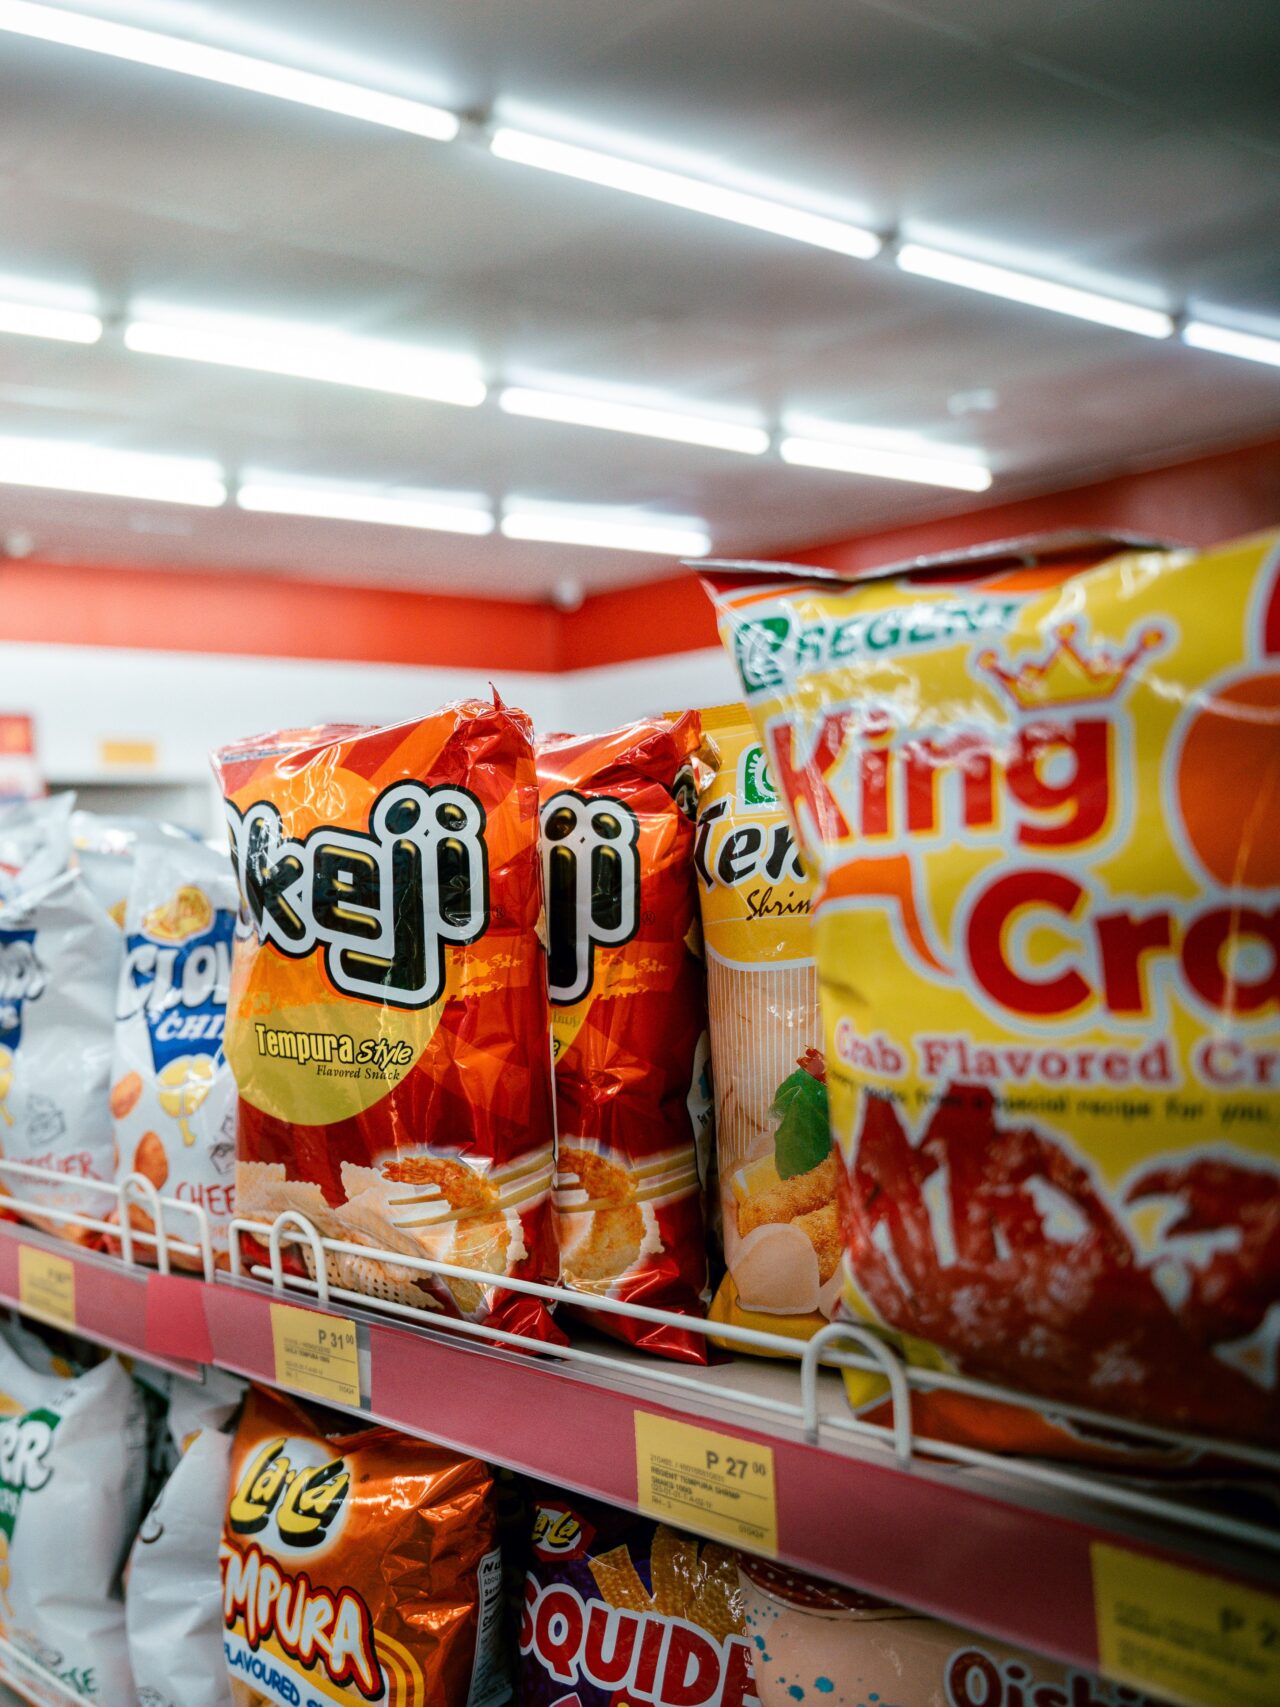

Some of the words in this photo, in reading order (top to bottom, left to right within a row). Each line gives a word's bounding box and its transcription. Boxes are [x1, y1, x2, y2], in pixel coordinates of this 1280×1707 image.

[770, 706, 1118, 852] King
[220, 782, 488, 1006] keji
[155, 1009, 226, 1042] CHI
[255, 1023, 355, 1064] Tempura
[355, 1037, 414, 1072] Style
[316, 1064, 361, 1080] Flavored
[364, 1068, 401, 1081] Snack
[920, 1037, 1174, 1083] Flavored
[318, 1329, 327, 1344] P
[330, 1332, 344, 1350] 31
[705, 1449, 719, 1470] P
[725, 1456, 749, 1480] 27
[221, 1545, 380, 1697] MPURA
